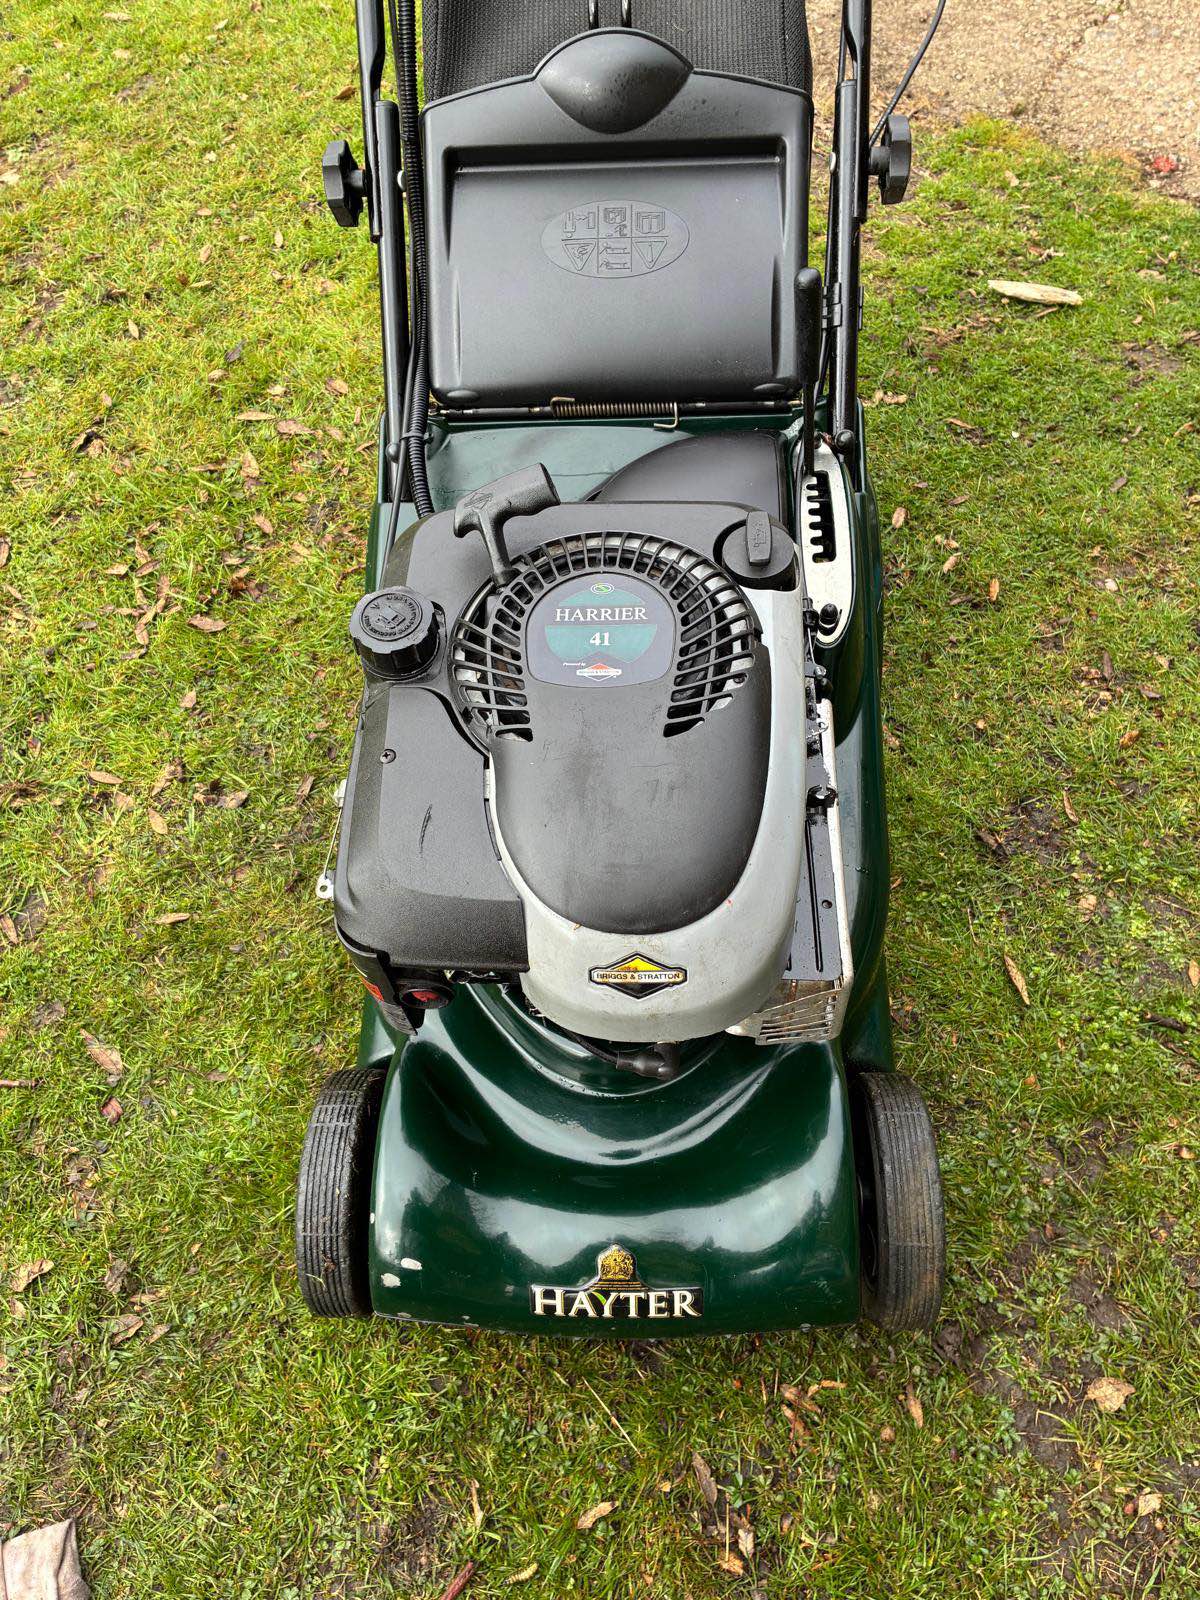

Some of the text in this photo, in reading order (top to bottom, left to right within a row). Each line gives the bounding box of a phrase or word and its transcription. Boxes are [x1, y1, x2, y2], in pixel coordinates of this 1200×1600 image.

[555, 607, 648, 622] HARRIER
[589, 631, 610, 646] 41
[637, 972, 680, 980] STRATTON
[532, 1287, 702, 1319] HAYTER
